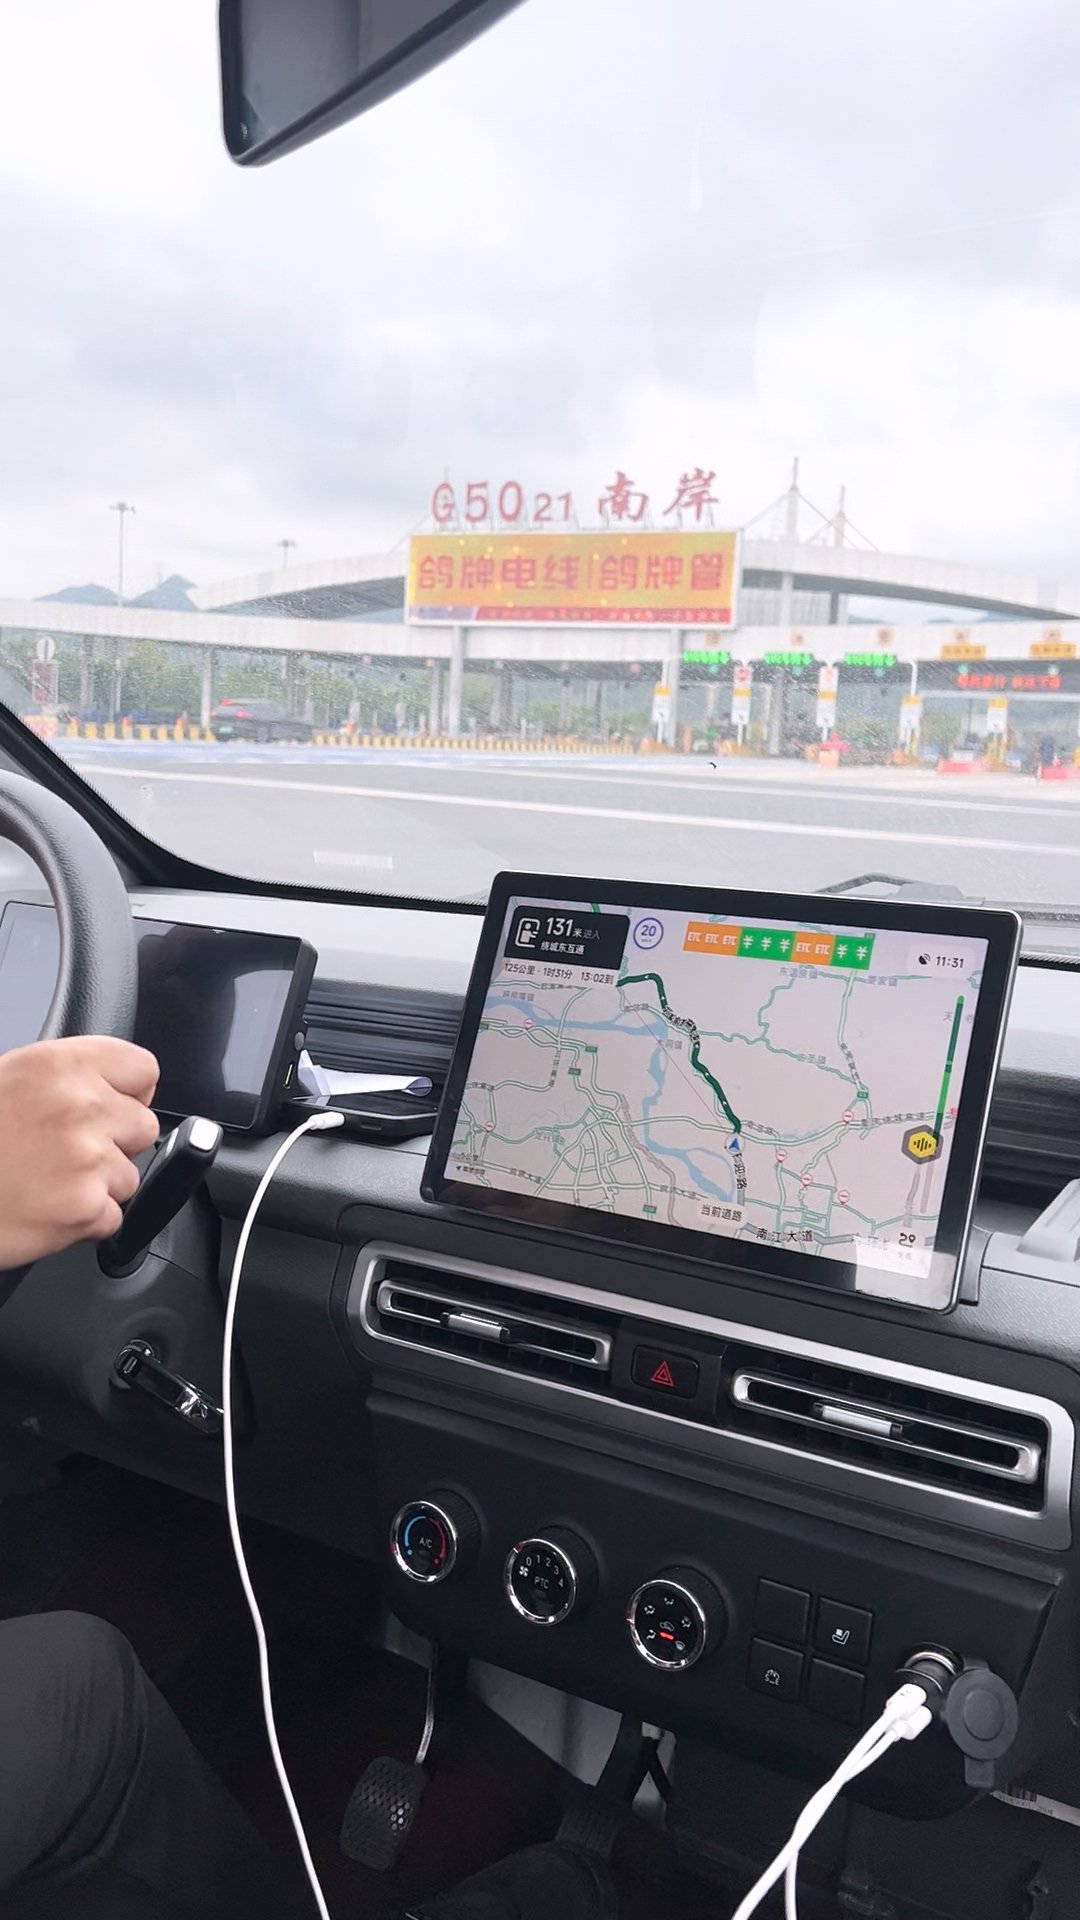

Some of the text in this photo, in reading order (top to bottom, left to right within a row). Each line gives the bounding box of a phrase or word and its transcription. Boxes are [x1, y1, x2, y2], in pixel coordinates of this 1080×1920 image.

[431, 467, 719, 523] G5021 南岸
[641, 925, 657, 937] 20
[935, 955, 965, 969] 11:31
[700, 1203, 743, 1222] 当前道路
[755, 1228, 814, 1242] 南江大道
[525, 1556, 532, 1567] 0
[536, 1554, 541, 1564] 1
[545, 1557, 551, 1568] 2
[553, 1565, 560, 1575] 3
[534, 1576, 550, 1589] PTC
